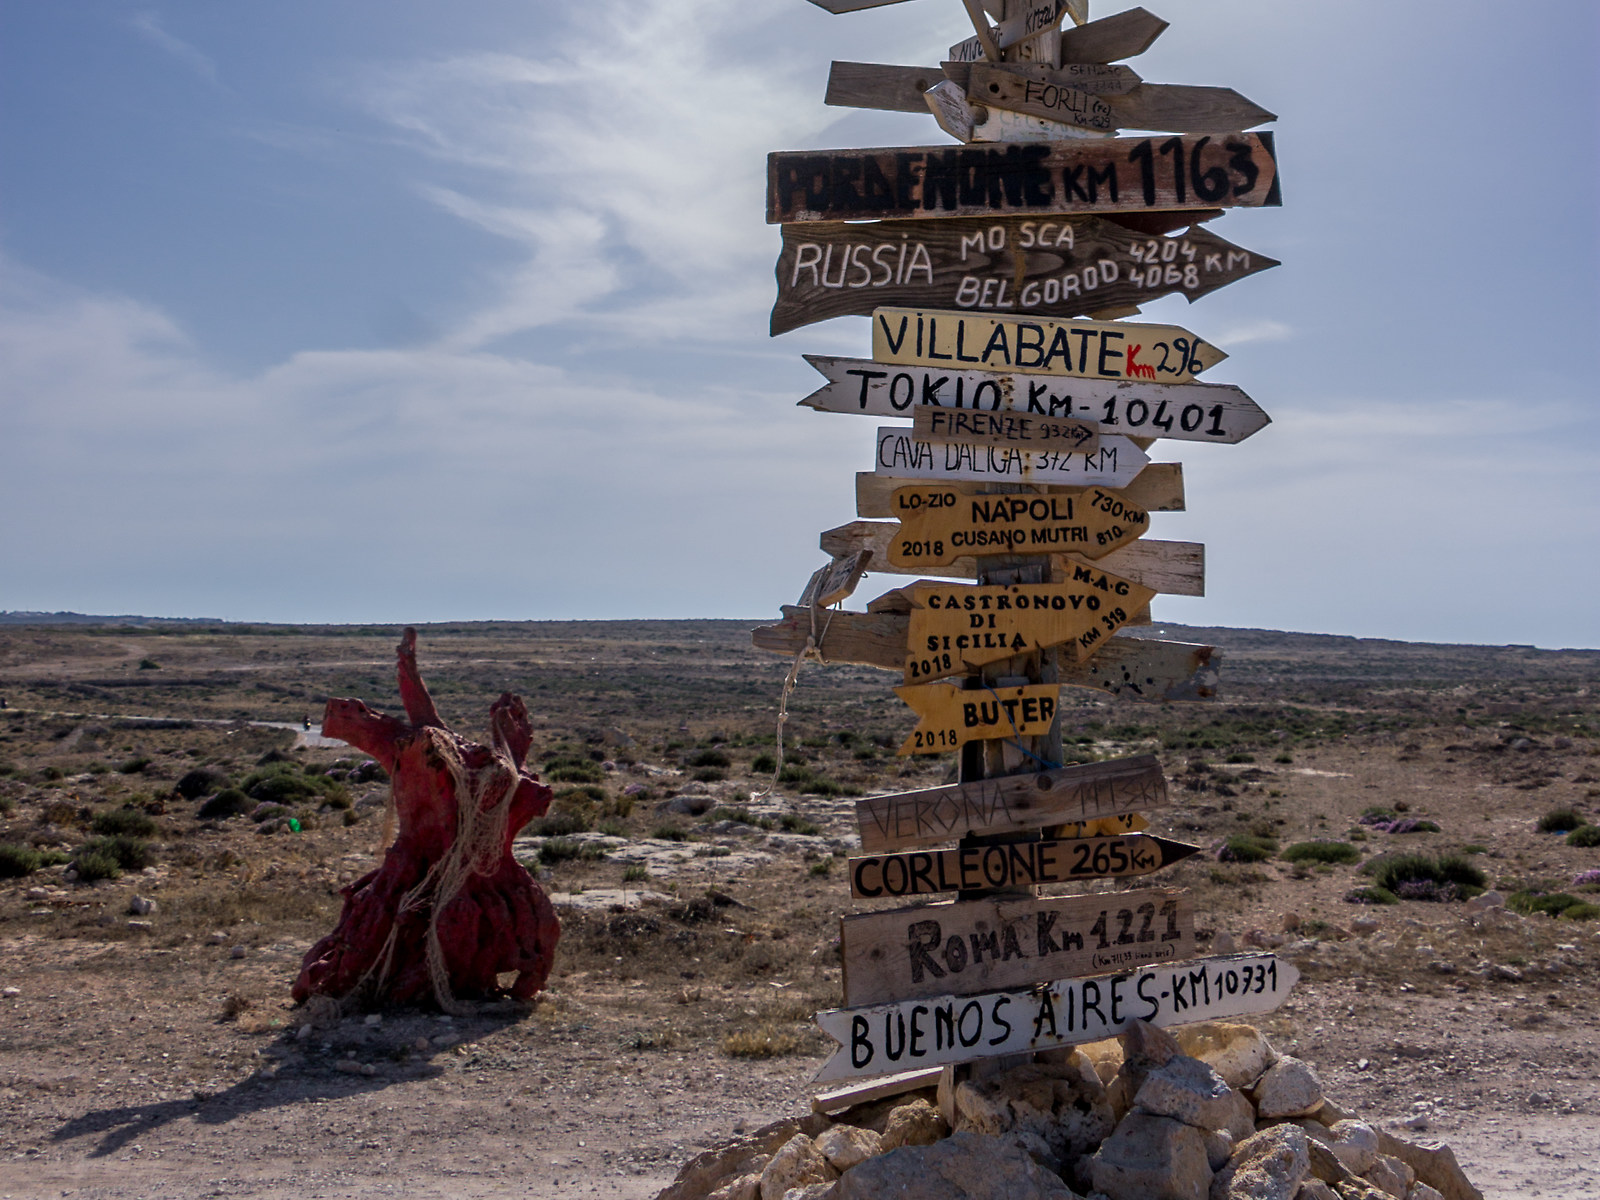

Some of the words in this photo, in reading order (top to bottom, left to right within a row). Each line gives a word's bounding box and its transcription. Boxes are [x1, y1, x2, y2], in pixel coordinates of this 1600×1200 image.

[1065, 162, 1119, 205] KM
[1128, 136, 1259, 206] 1163
[792, 233, 934, 289] RUSSIA
[1129, 238, 1196, 265] 4204
[1206, 250, 1250, 273] KM
[1129, 264, 1200, 290] 4068
[879, 312, 1125, 377] VILLABATE
[1153, 337, 1204, 376] 296
[847, 368, 1001, 412] TOKIO
[931, 412, 1033, 440] FIRENZE
[879, 435, 934, 470] CAVA
[1084, 447, 1118, 472] KM
[899, 493, 957, 509] LO-ZIO
[971, 498, 1074, 523] NAPOLI
[901, 540, 945, 556] 2018
[951, 529, 1026, 547] CUSANO
[1031, 526, 1089, 544] MUTRI
[1096, 525, 1124, 546] 810
[928, 594, 1101, 611] CASTRONOVO
[970, 613, 996, 628] DI
[1078, 626, 1101, 648] KM
[1102, 607, 1127, 630] 319
[927, 632, 1027, 651] SICILIA
[910, 653, 951, 677] 2018
[914, 729, 957, 747] 2018
[868, 783, 1013, 841] VERONA
[855, 842, 1058, 896] CORLEONE
[851, 998, 1011, 1069] BUENOS
